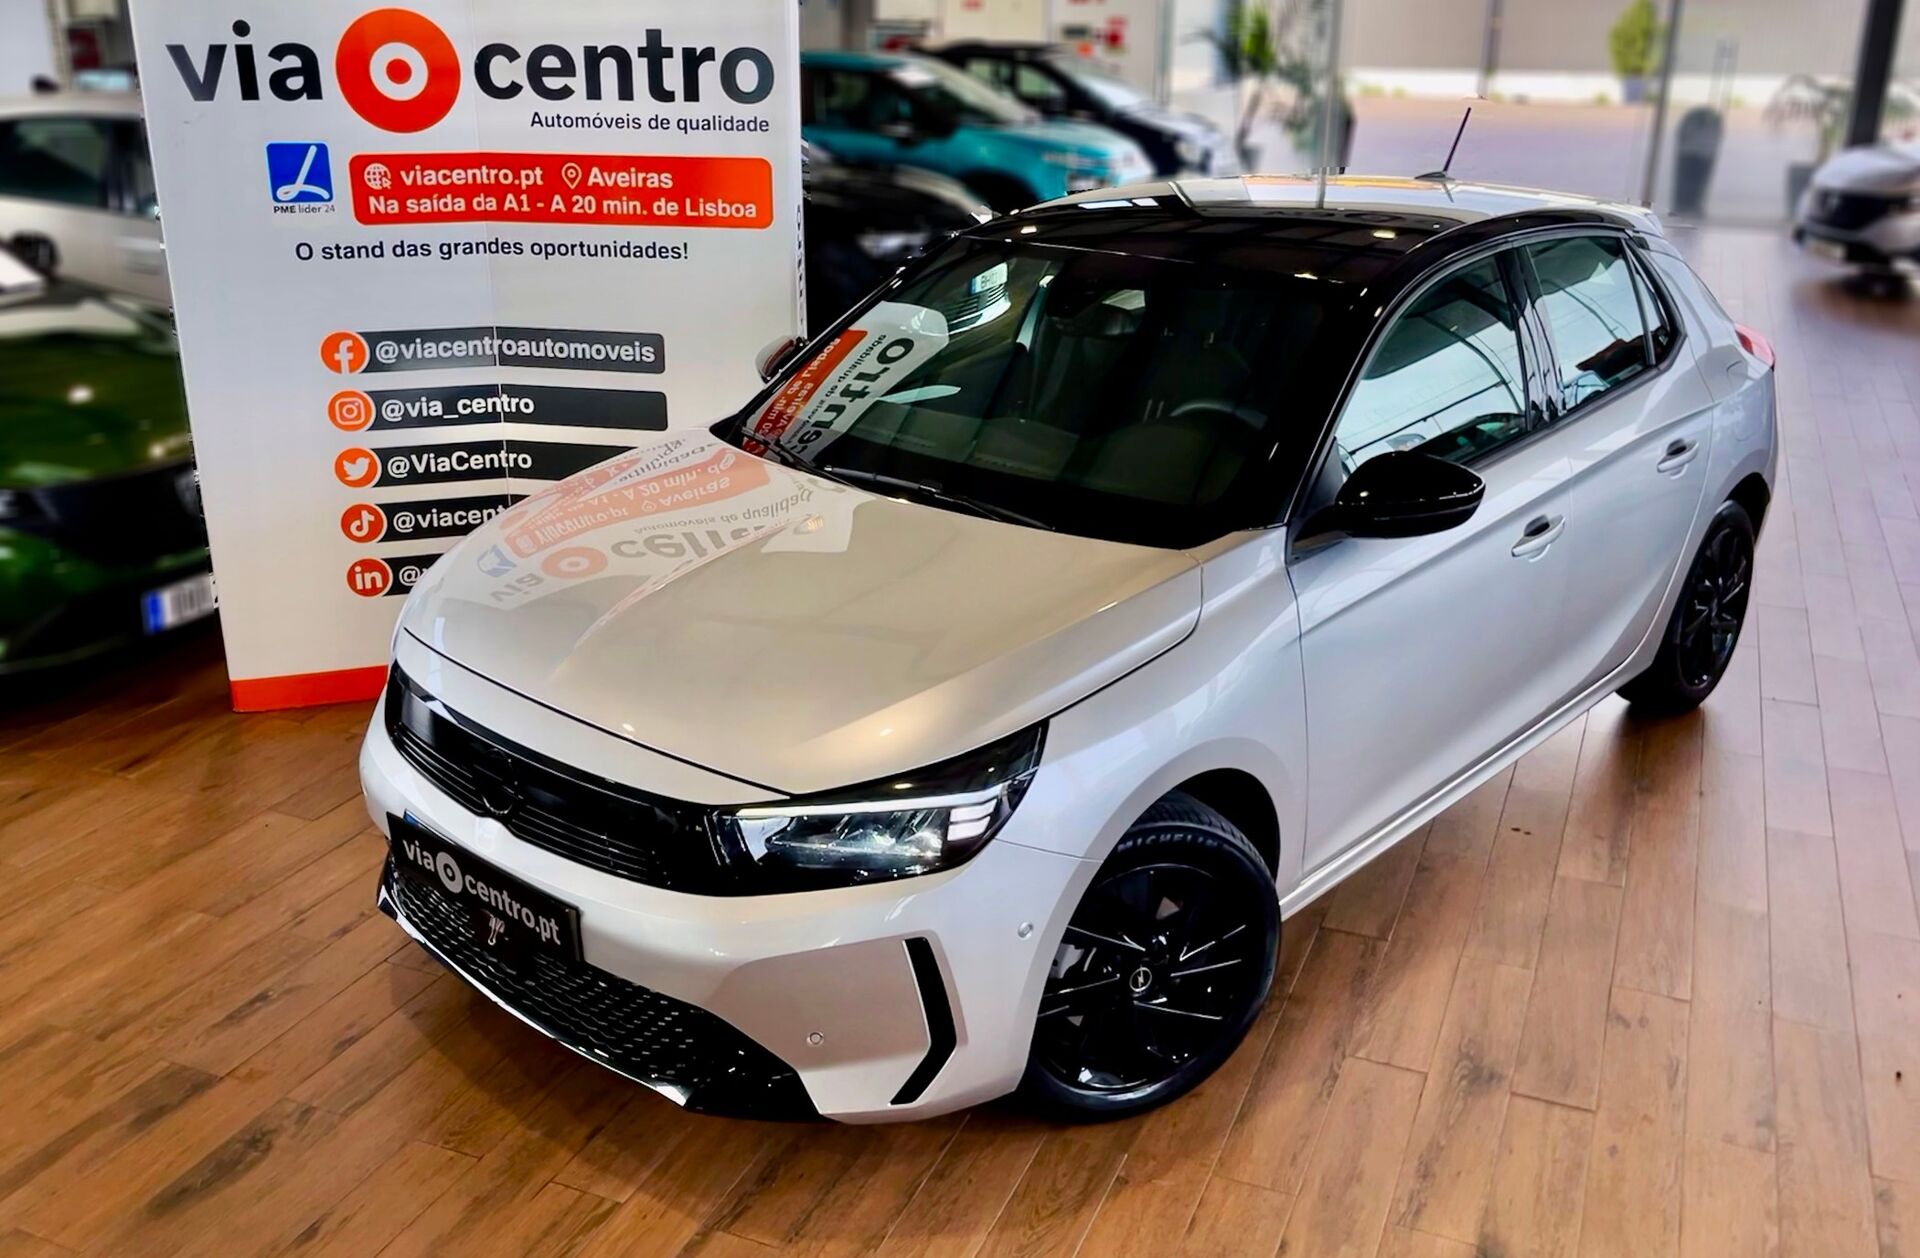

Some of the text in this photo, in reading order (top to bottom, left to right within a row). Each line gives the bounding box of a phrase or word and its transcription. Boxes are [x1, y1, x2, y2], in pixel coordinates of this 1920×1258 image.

[166, 19, 775, 104] via centro
[530, 112, 770, 135] Automóveis de qualidade
[400, 164, 674, 189] viacentro.pt Aveiras
[273, 205, 297, 214] PME
[368, 195, 400, 214] Na
[406, 193, 466, 213] saída
[472, 193, 498, 212] da
[503, 193, 531, 212] A1
[550, 194, 566, 213] A
[572, 195, 597, 214] 20
[602, 196, 648, 215] min.
[652, 197, 679, 216] de
[685, 198, 758, 218] Lisboa
[295, 238, 689, 261] O stand das grandes oportunidades!
[375, 335, 656, 364] @viacentroautomoveis
[381, 392, 535, 422] @via_centro
[387, 449, 533, 480] @ViaCentro
[402, 839, 561, 945] via centro.pt
